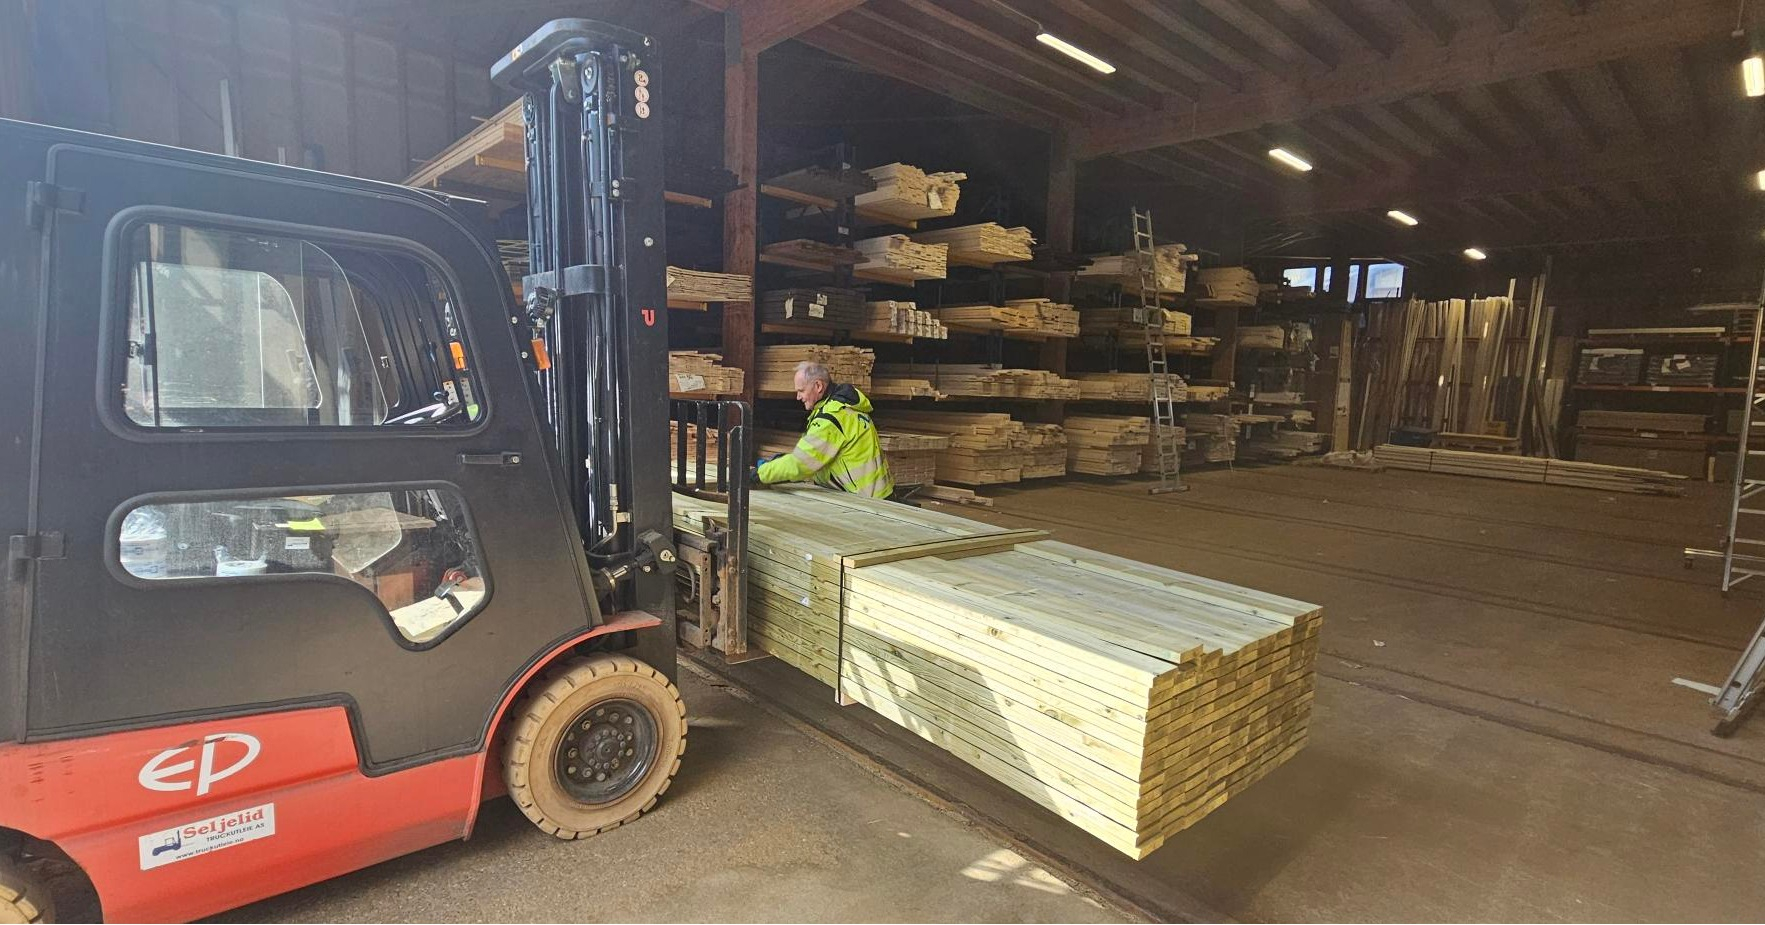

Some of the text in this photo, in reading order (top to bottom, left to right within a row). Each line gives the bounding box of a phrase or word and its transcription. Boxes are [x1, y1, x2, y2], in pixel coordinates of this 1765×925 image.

[138, 733, 261, 796] EP
[183, 808, 264, 839] Seljelid
[206, 826, 254, 842] TRUCKUTLEIE
